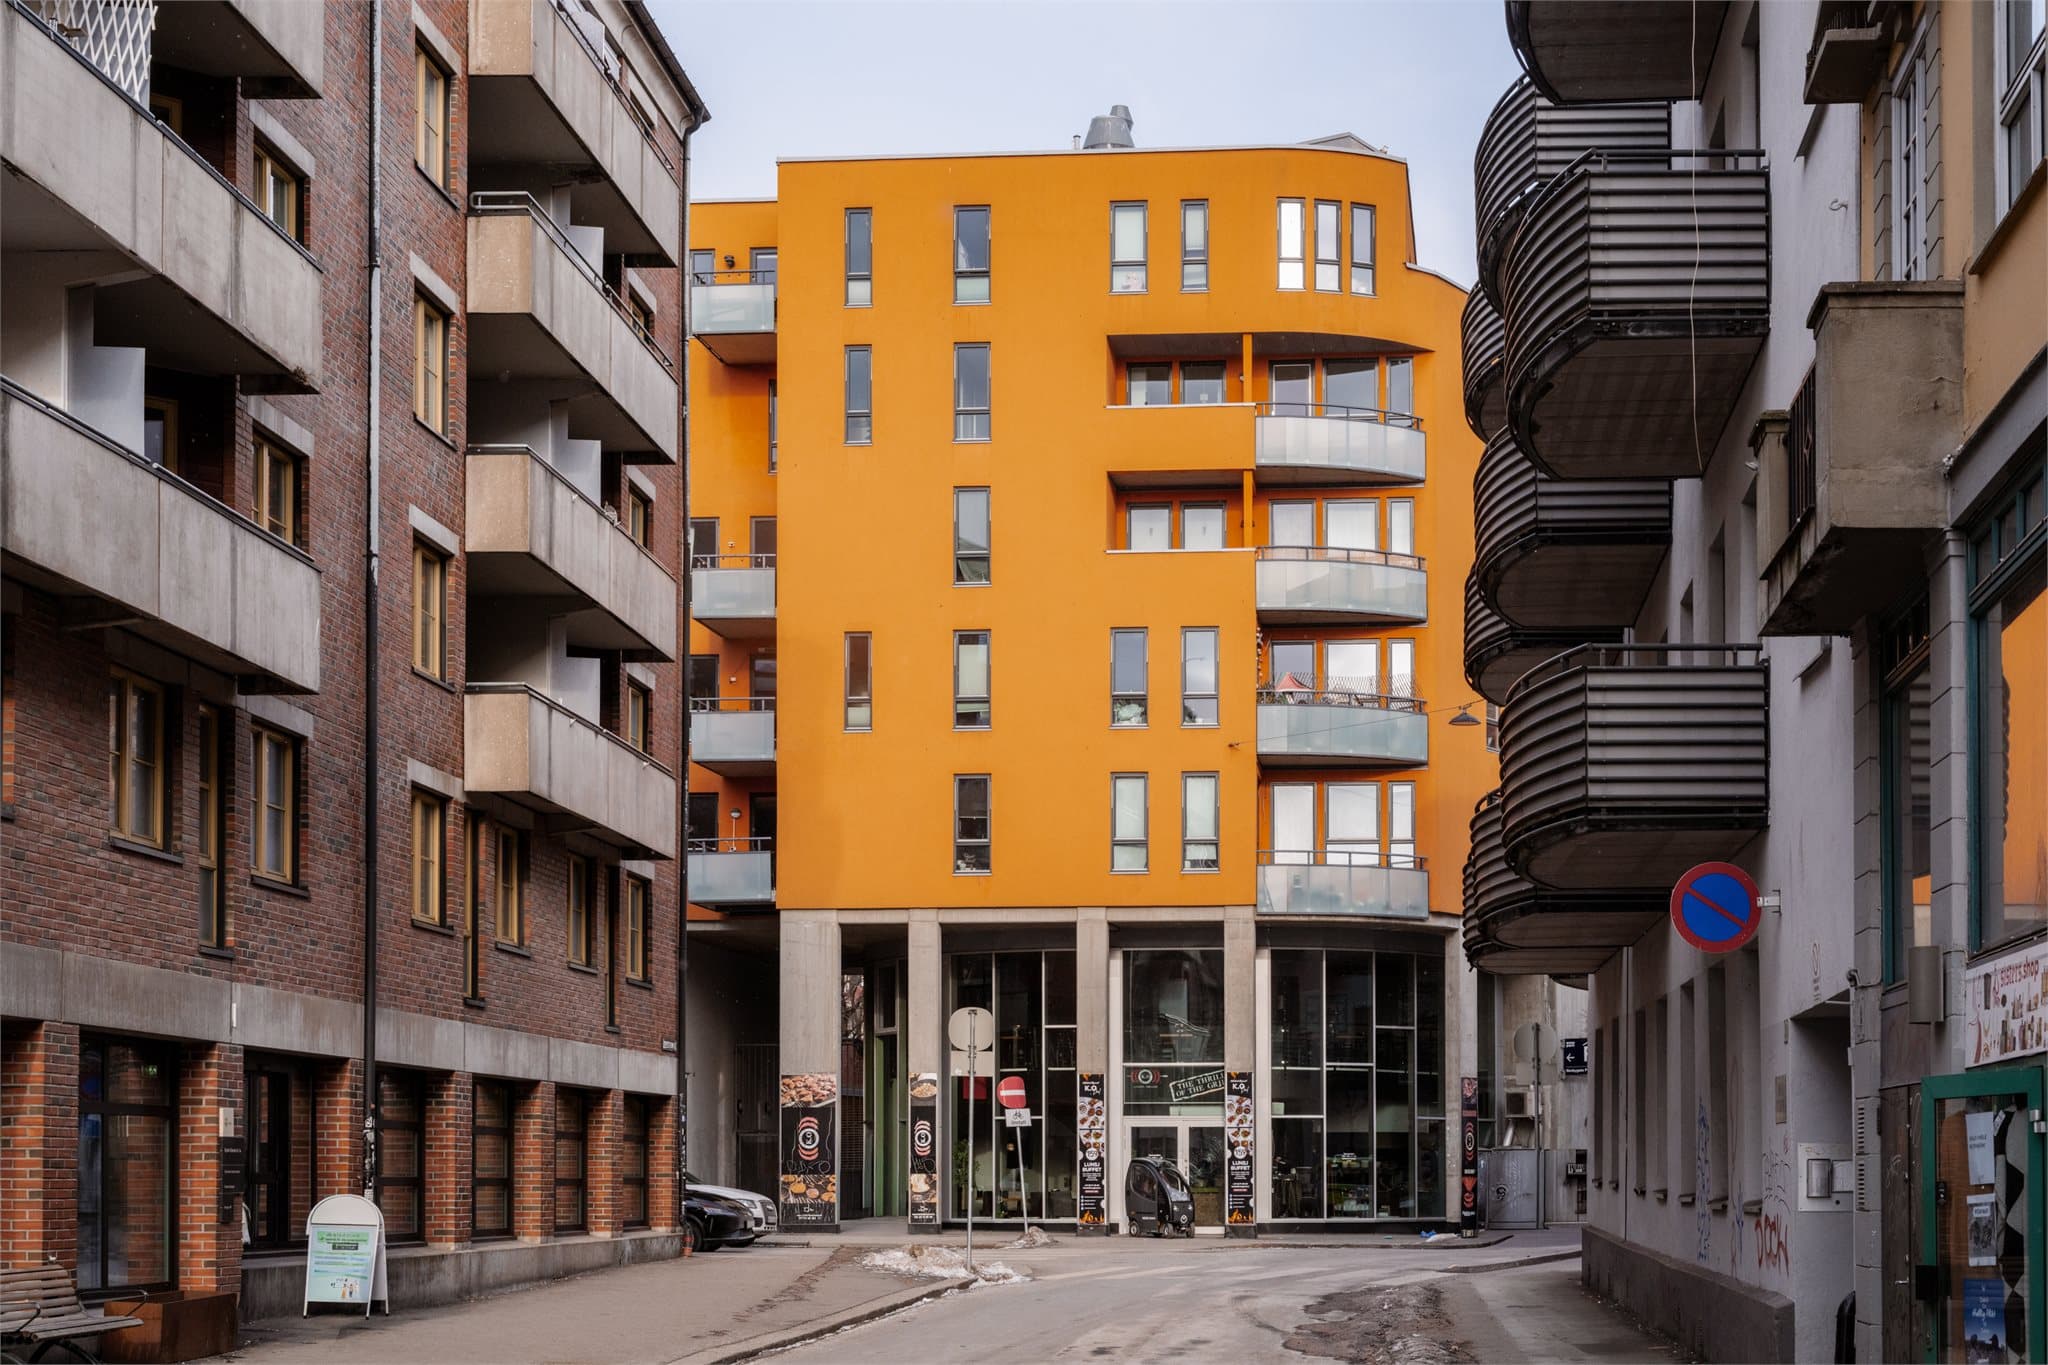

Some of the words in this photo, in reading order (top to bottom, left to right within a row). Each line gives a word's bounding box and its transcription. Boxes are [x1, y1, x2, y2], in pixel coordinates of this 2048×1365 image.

[1175, 1089, 1184, 1097] OF
[1188, 1084, 1204, 1094] THE
[1177, 1080, 1193, 1090] THE
